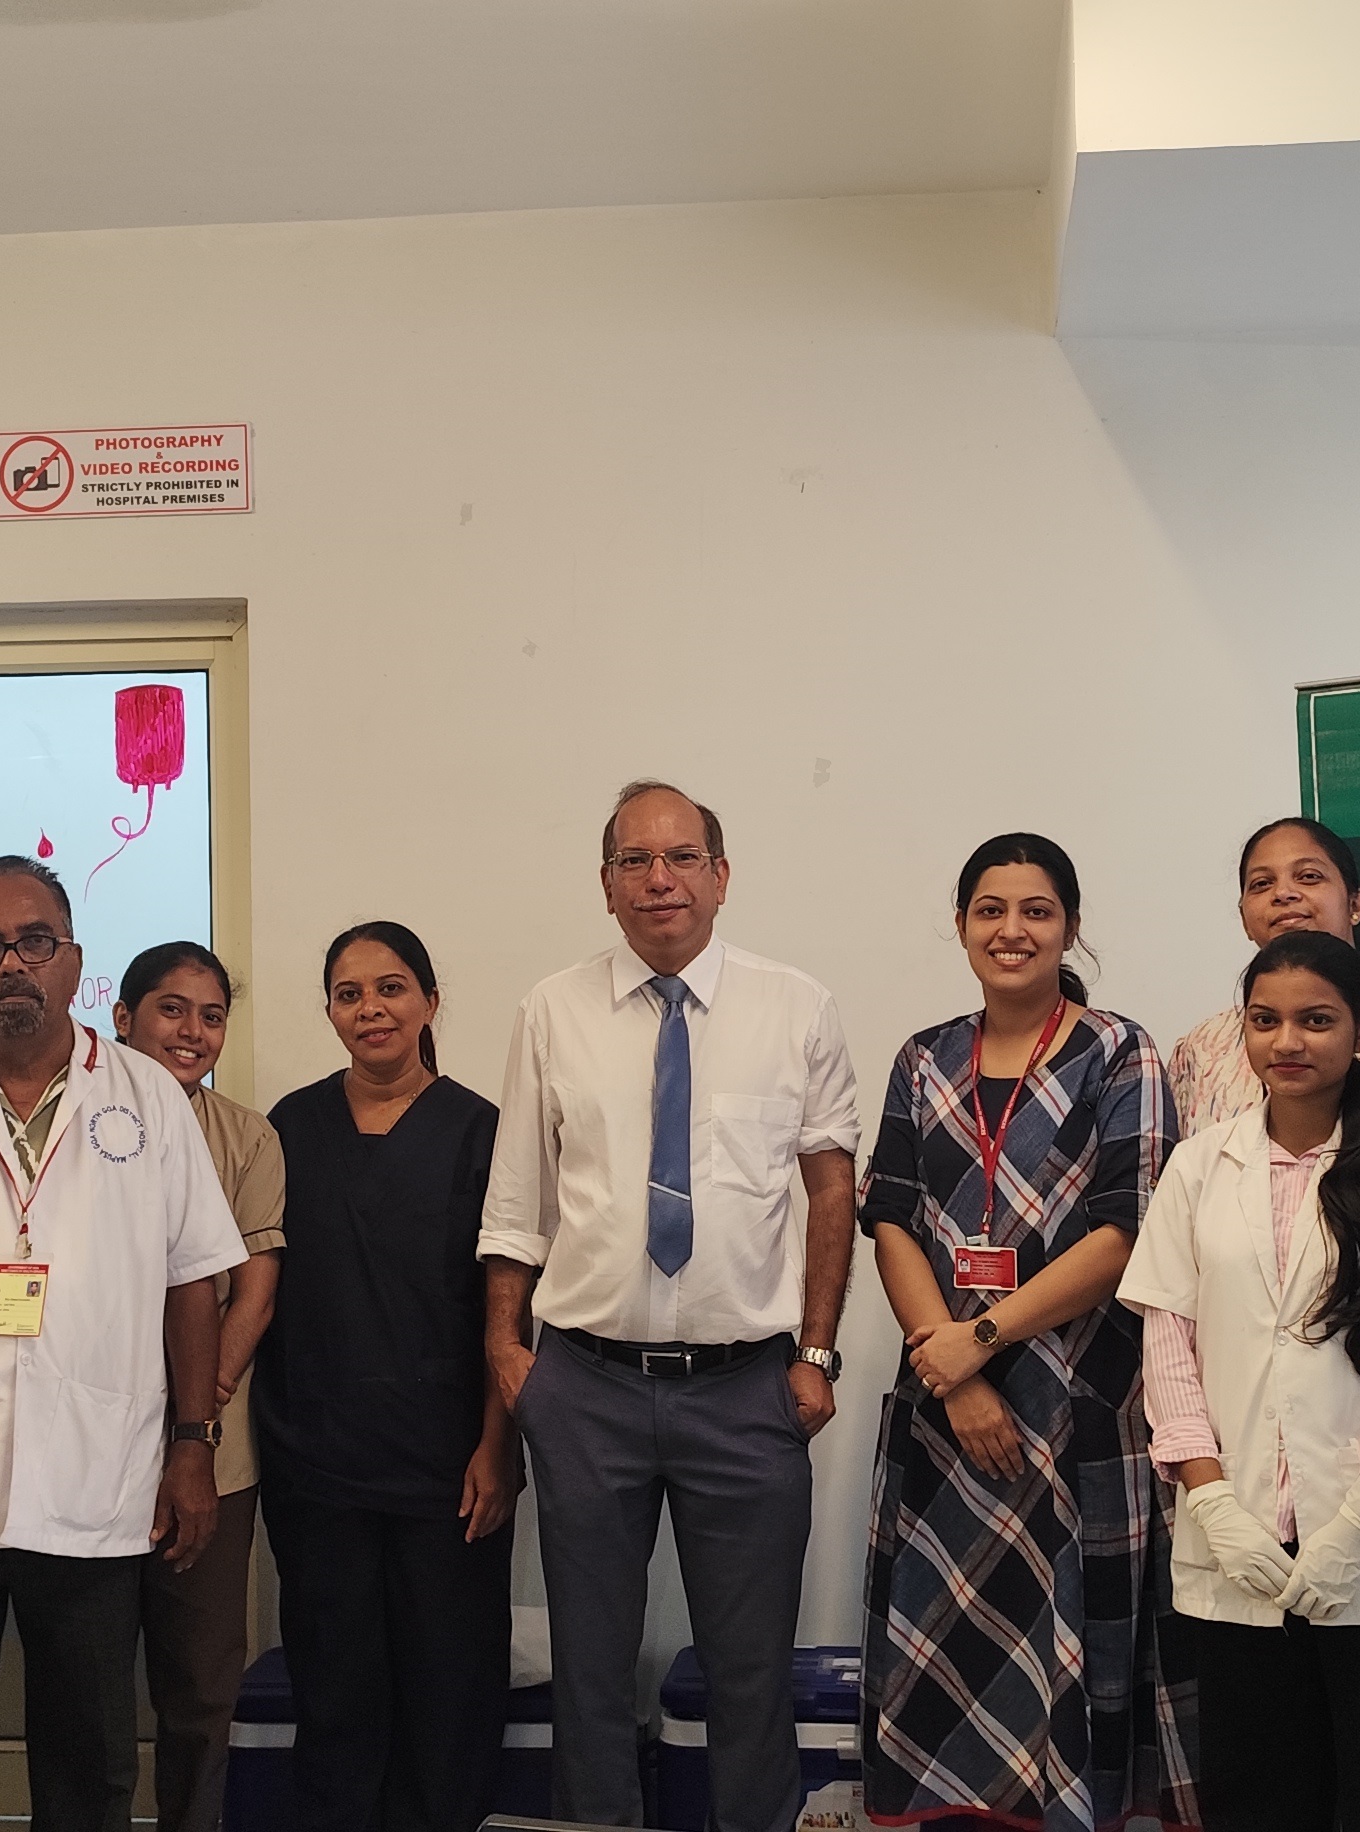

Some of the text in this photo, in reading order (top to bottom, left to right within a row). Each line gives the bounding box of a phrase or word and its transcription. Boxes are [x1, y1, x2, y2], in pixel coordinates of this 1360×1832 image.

[94, 434, 224, 451] PHOTOGRAPHY
[155, 451, 164, 460] &
[80, 458, 240, 476] VIDEO RECORDING
[81, 478, 240, 493] STRICTLY PROHIBITED IN
[96, 493, 225, 507] HOSPITAL PREMISES
[71, 976, 113, 1010] OR
[101, 1104, 118, 1114] GOA
